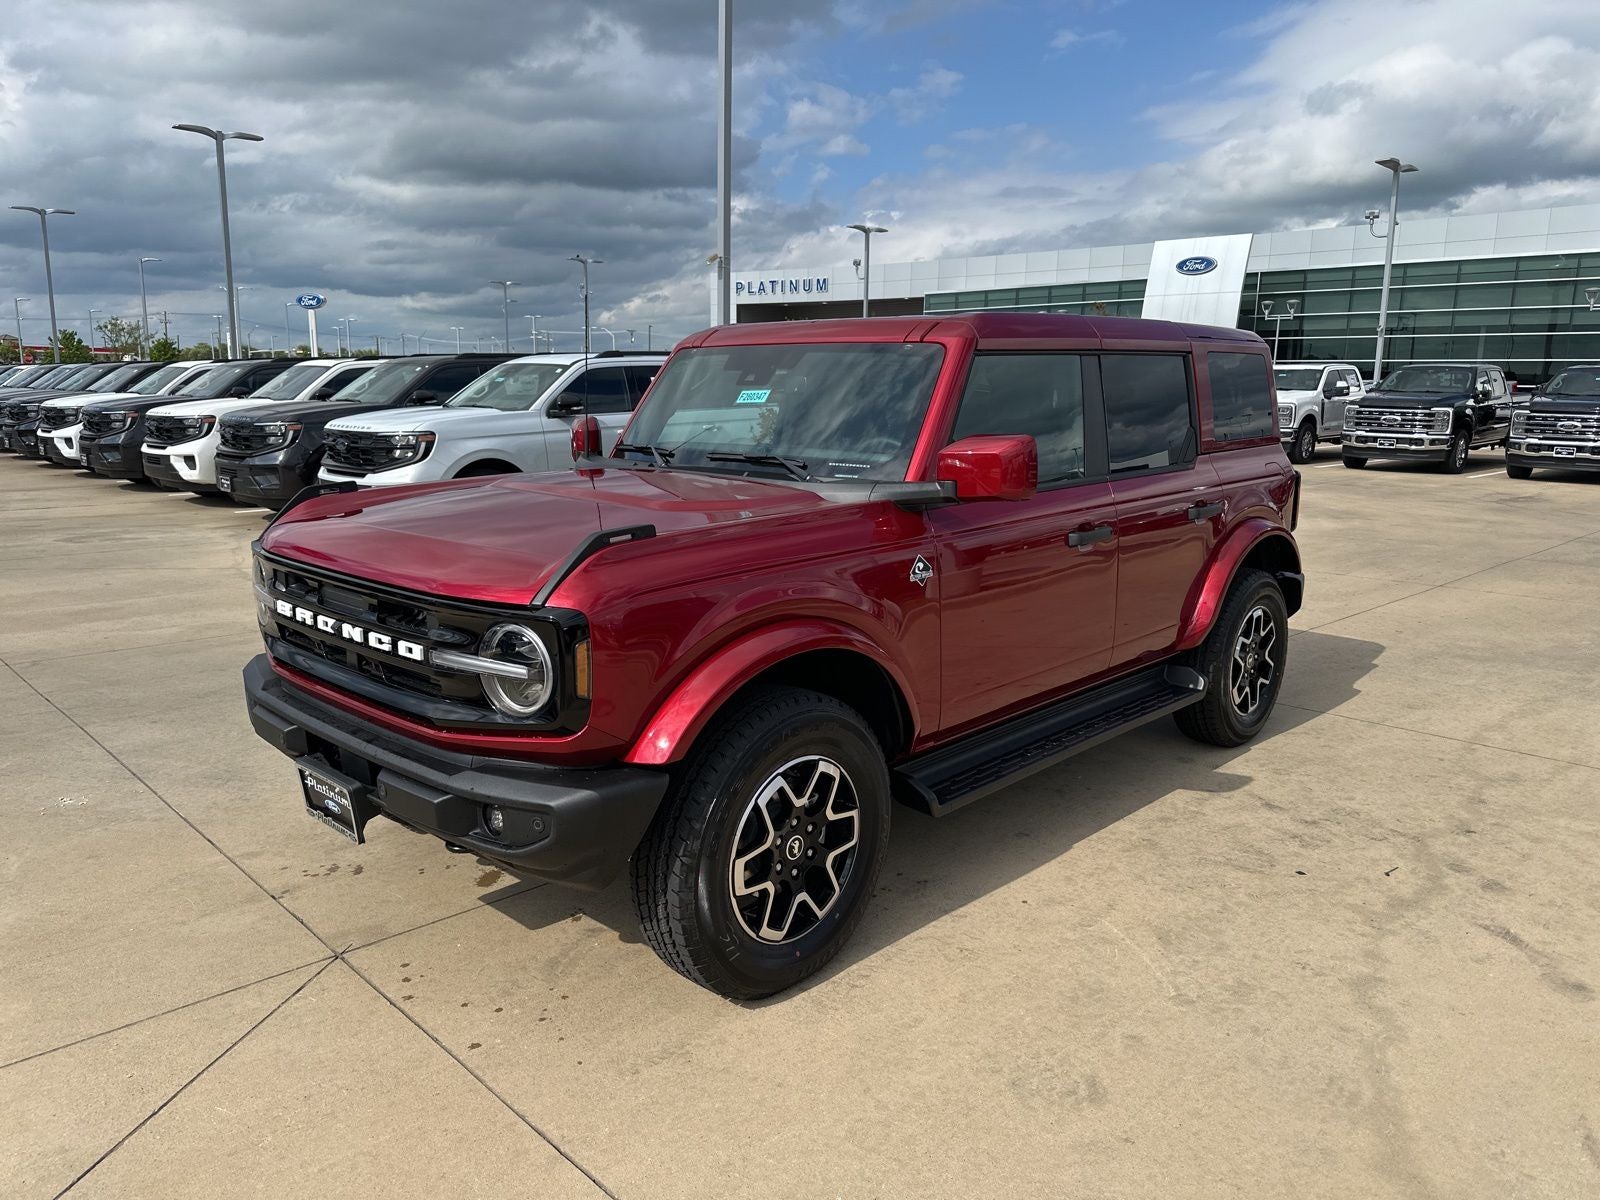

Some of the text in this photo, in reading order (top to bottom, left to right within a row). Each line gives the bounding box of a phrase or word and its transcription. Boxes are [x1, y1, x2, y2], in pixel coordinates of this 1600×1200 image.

[1183, 259, 1207, 271] Ford
[735, 278, 829, 296] PLATINUM
[300, 295, 318, 306] Ford
[276, 599, 425, 662] BRONCO
[305, 776, 351, 810] Platinum
